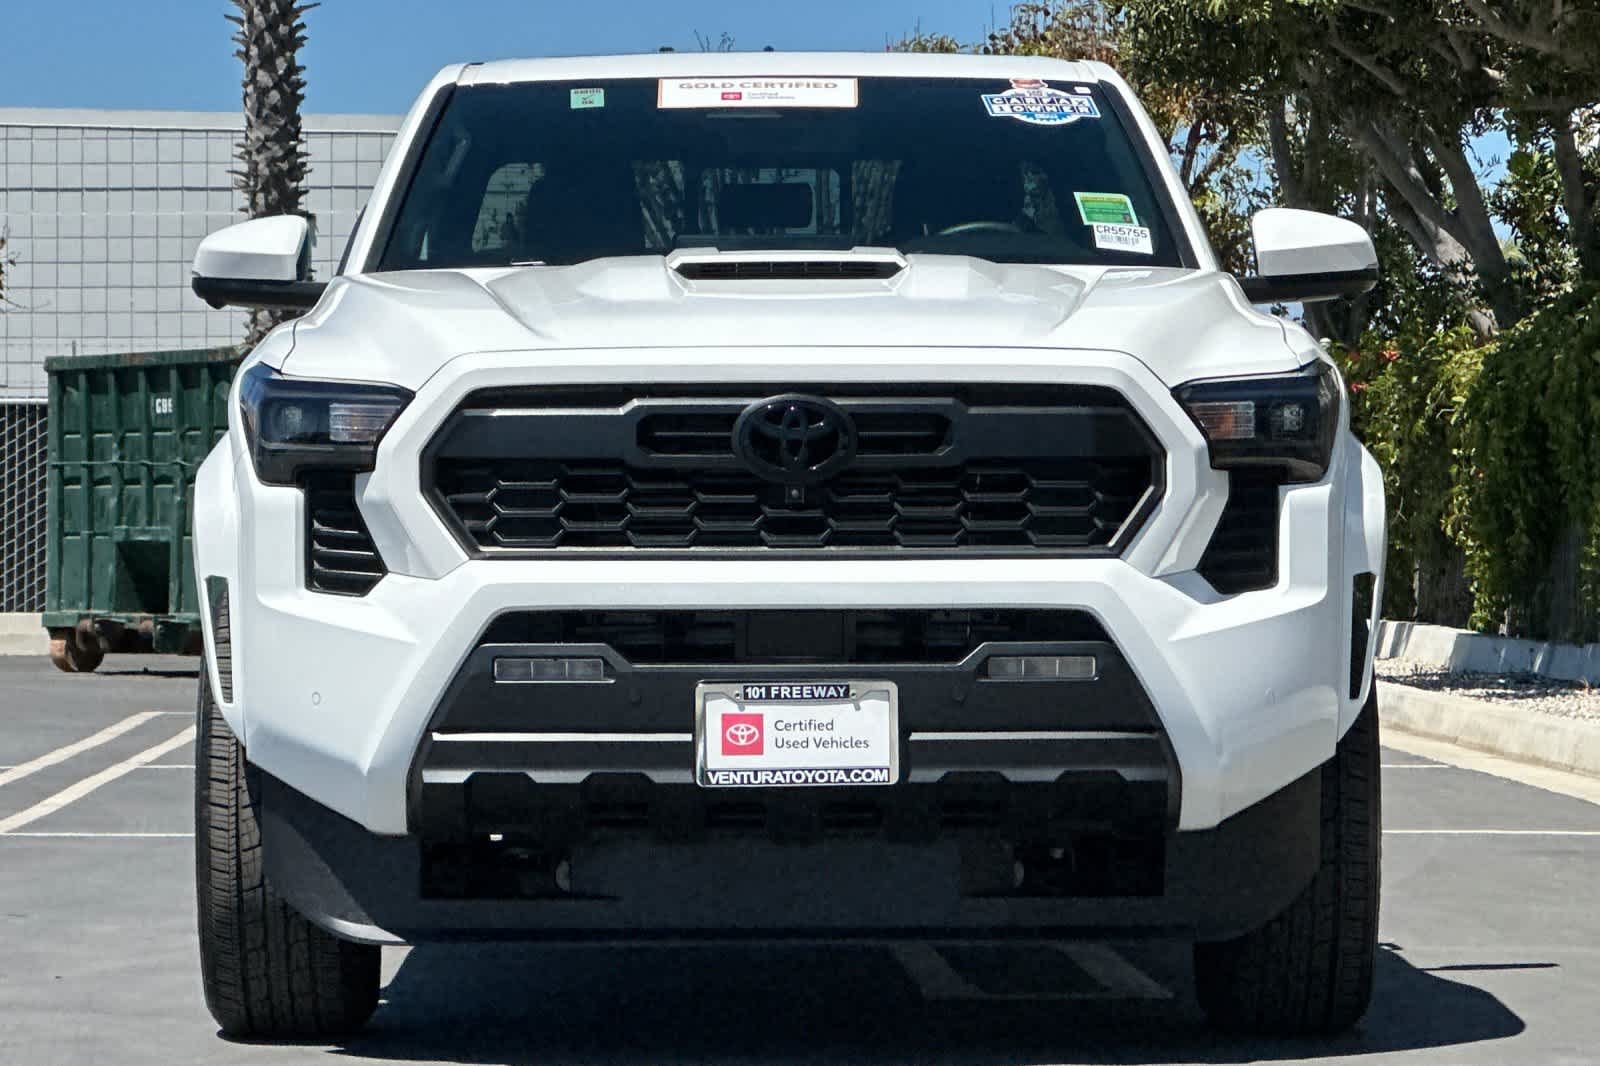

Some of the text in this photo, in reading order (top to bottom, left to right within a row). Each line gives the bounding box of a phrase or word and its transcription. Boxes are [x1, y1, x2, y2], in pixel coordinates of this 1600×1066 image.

[679, 81, 838, 89] GOLD CERTIFIED
[991, 96, 1088, 105] CARFAX
[1096, 225, 1148, 238] CR55755
[745, 686, 846, 699] 101 FREEWAY
[774, 719, 834, 732] Certified
[774, 737, 870, 749] Used Vehicles
[707, 769, 889, 784] VENTURATOYOTA.COM
